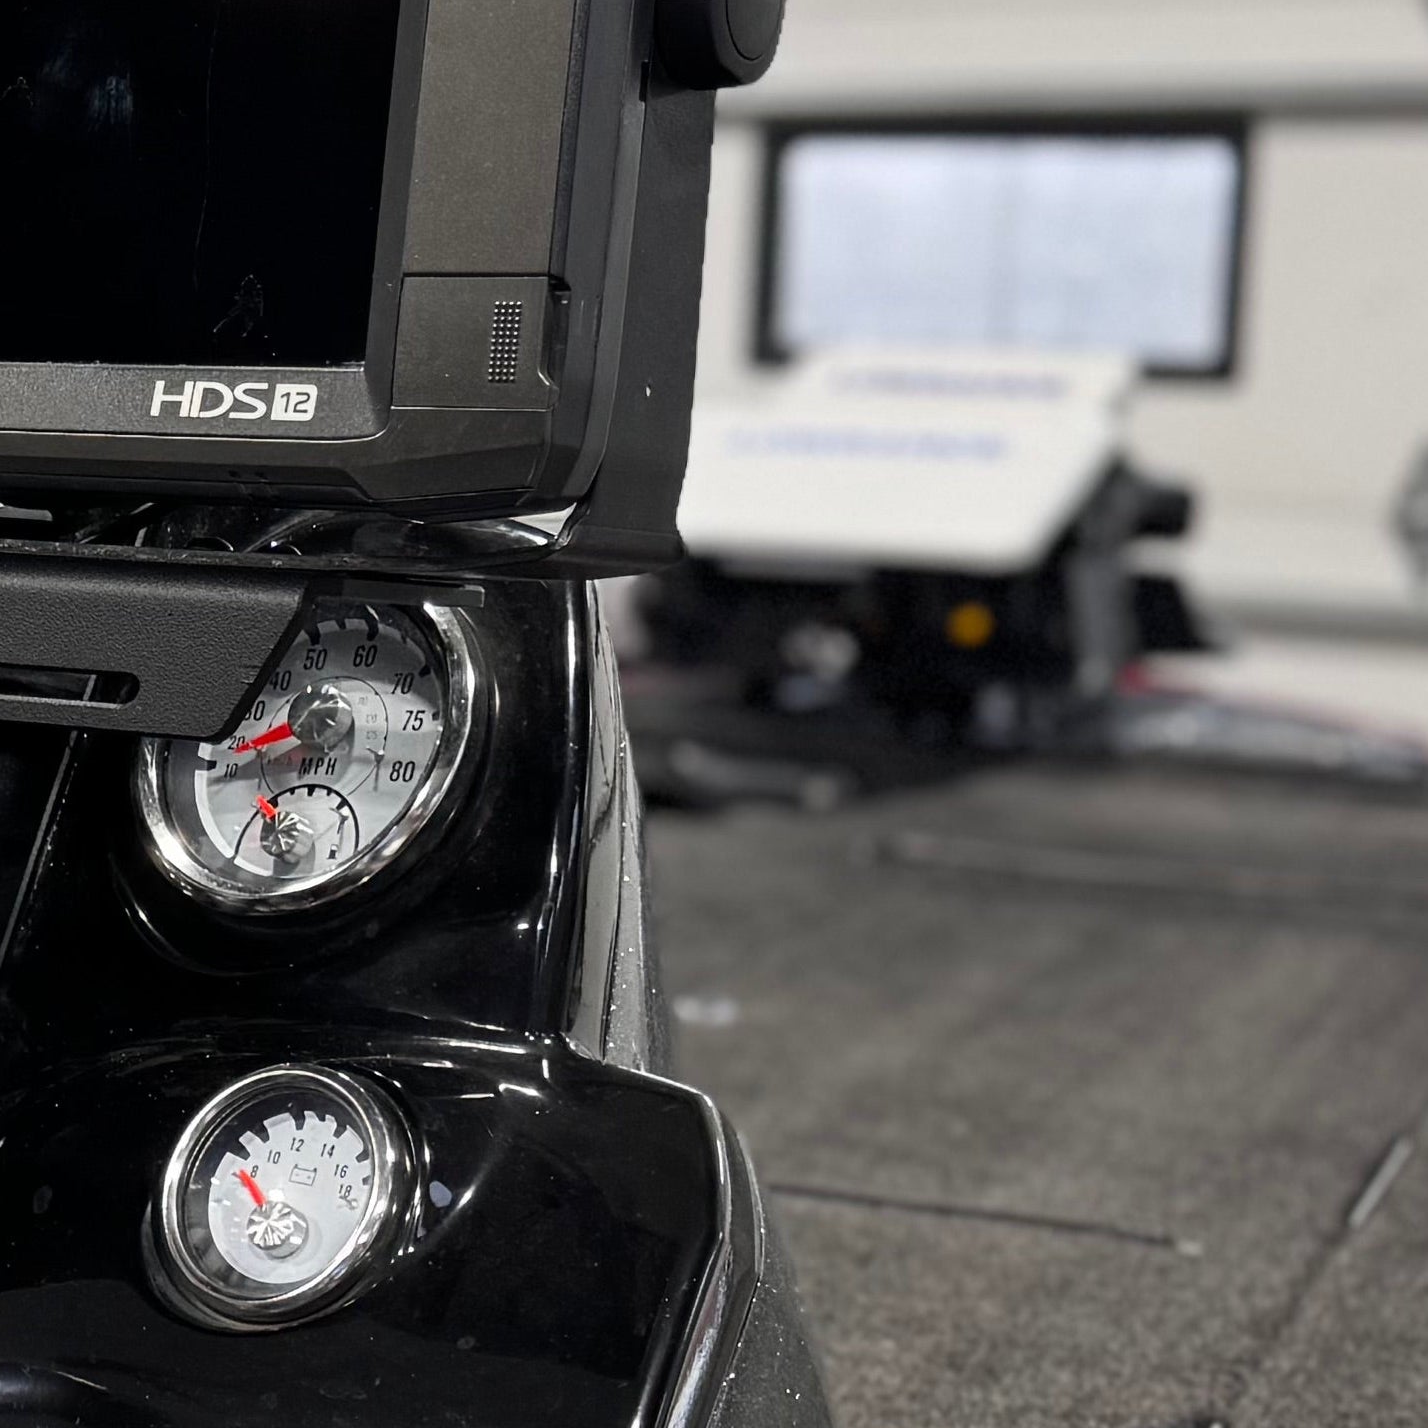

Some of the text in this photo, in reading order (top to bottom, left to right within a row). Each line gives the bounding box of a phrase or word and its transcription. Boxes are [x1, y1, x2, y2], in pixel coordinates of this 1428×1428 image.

[303, 648, 327, 670] 50
[353, 645, 377, 667] 60
[391, 673, 414, 694] 70
[402, 710, 425, 731] 75
[224, 763, 238, 778] 10
[298, 758, 338, 776] MPH
[389, 760, 415, 782] 80
[290, 1137, 304, 1152] 12
[320, 1143, 335, 1158] 14
[266, 1149, 281, 1164] 10
[250, 1165, 259, 1178] 8
[334, 1164, 348, 1178] 16
[339, 1184, 352, 1198] 18
